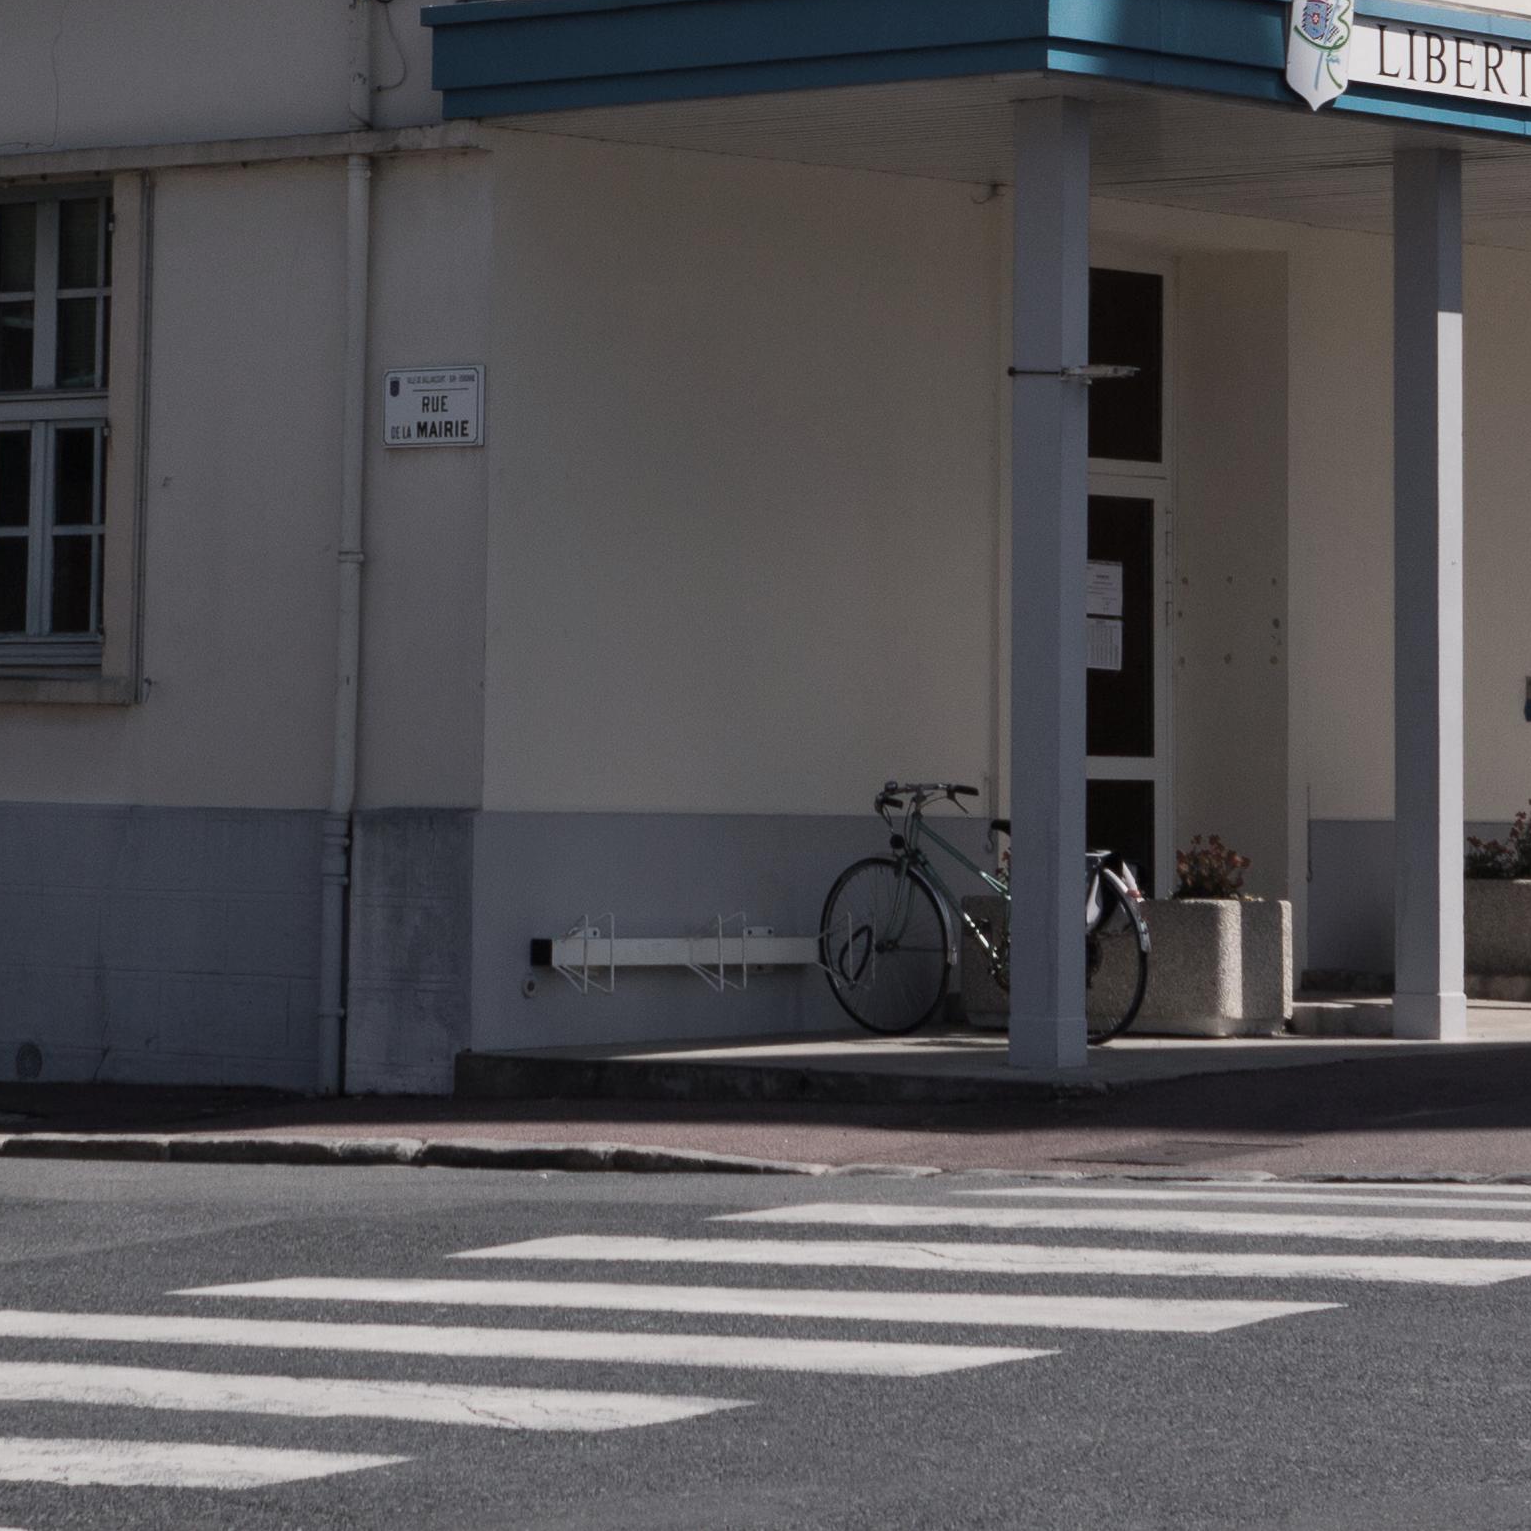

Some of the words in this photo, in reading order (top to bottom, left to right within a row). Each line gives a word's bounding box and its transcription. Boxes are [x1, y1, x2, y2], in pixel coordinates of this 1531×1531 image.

[422, 395, 448, 413] RUE
[391, 425, 400, 439] DE
[402, 425, 411, 439] LA
[416, 419, 469, 438] MAIRIE
